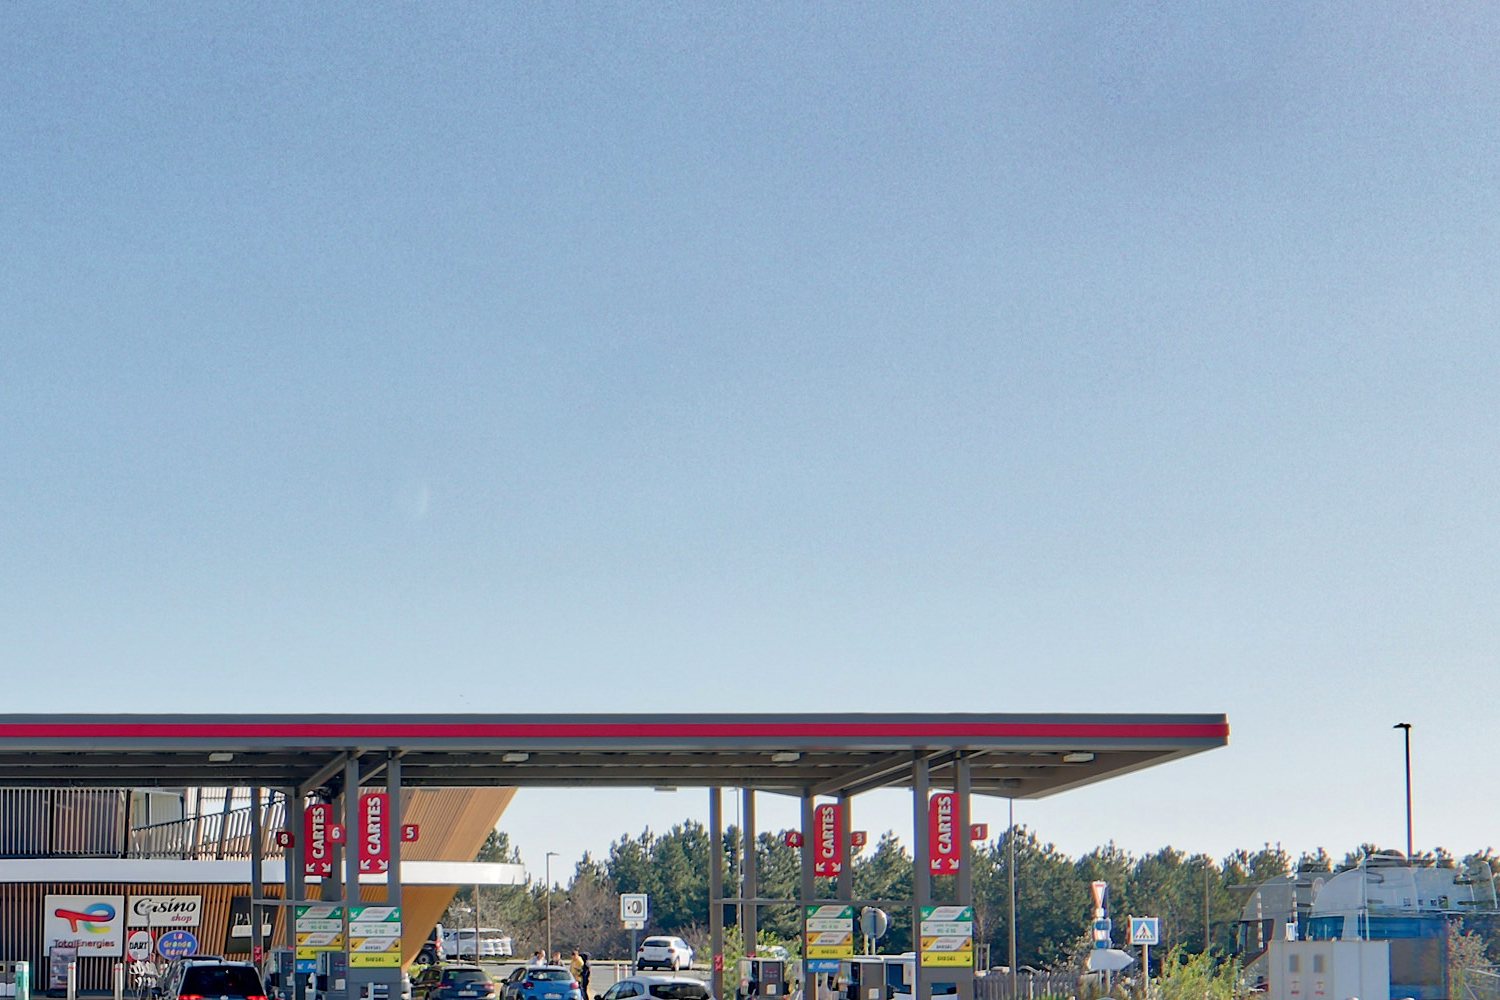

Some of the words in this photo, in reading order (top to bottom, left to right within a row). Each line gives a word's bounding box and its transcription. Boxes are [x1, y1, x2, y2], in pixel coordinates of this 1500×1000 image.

[367, 797, 381, 855] CARTES
[938, 797, 952, 855] CARTES
[975, 827, 982, 837] 1
[280, 833, 289, 845] 8
[312, 807, 325, 859] CARTES
[331, 827, 340, 839] 6
[405, 827, 415, 839] 5
[789, 833, 797, 844] 4
[822, 807, 835, 859] CARTES
[855, 833, 863, 844] 3
[171, 914, 192, 923] shop
[54, 938, 115, 949] TotalEnergies
